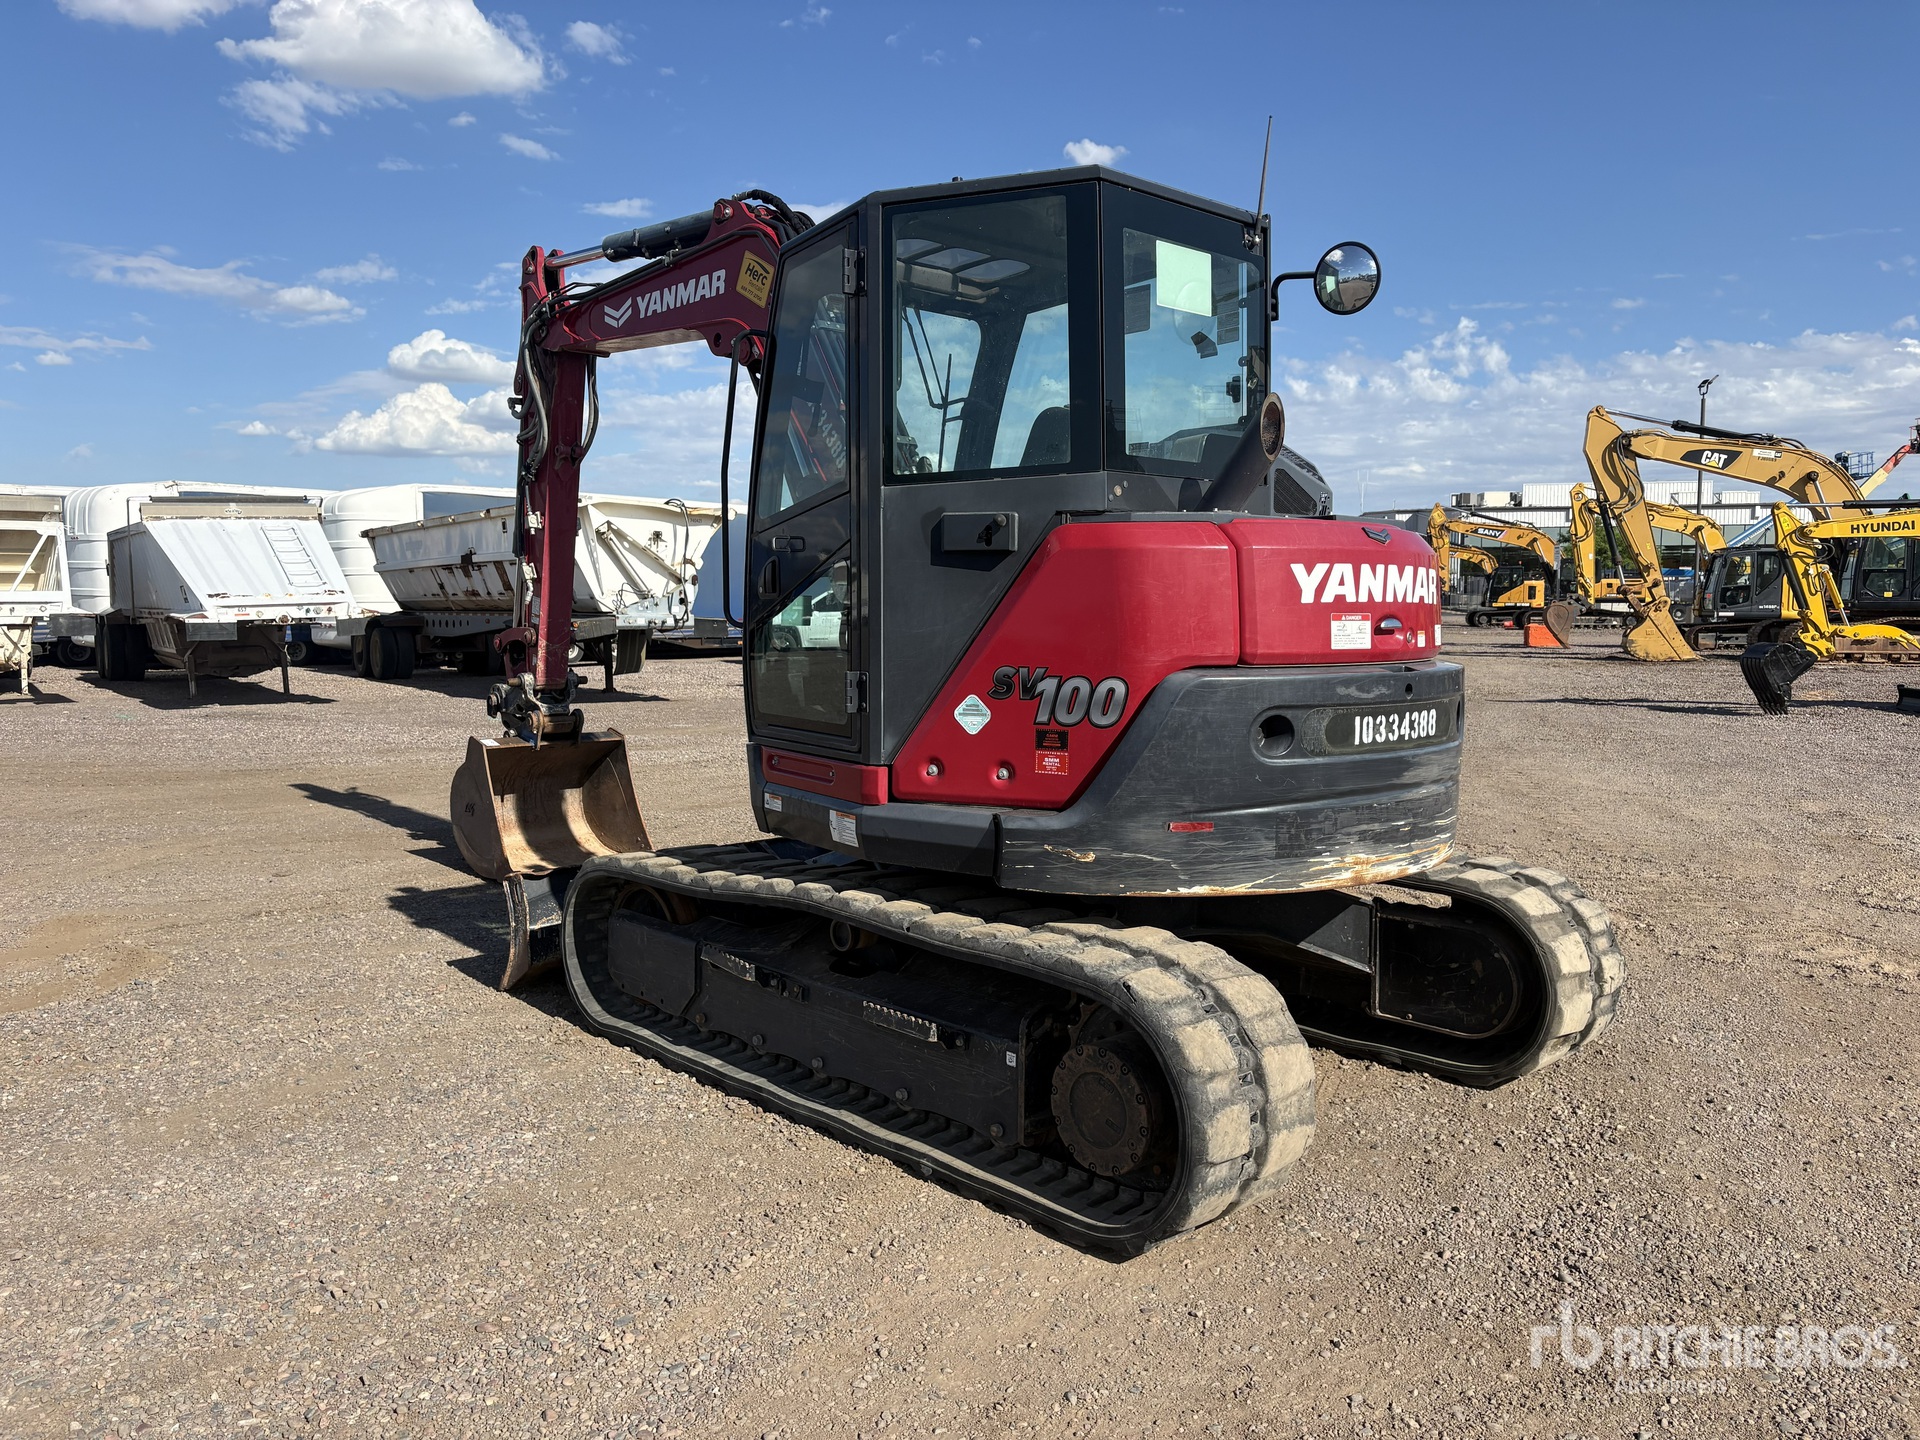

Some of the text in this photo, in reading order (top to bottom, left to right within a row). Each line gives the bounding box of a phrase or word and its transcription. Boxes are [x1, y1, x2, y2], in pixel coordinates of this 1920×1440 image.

[745, 263, 768, 286] Herc
[637, 269, 726, 319] YANMAR
[1701, 450, 1728, 469] CAT
[1477, 528, 1502, 538] SANY
[1851, 520, 1916, 534] HYUNDAI
[1290, 563, 1437, 605] YANMAR
[1354, 708, 1437, 746] 10334388
